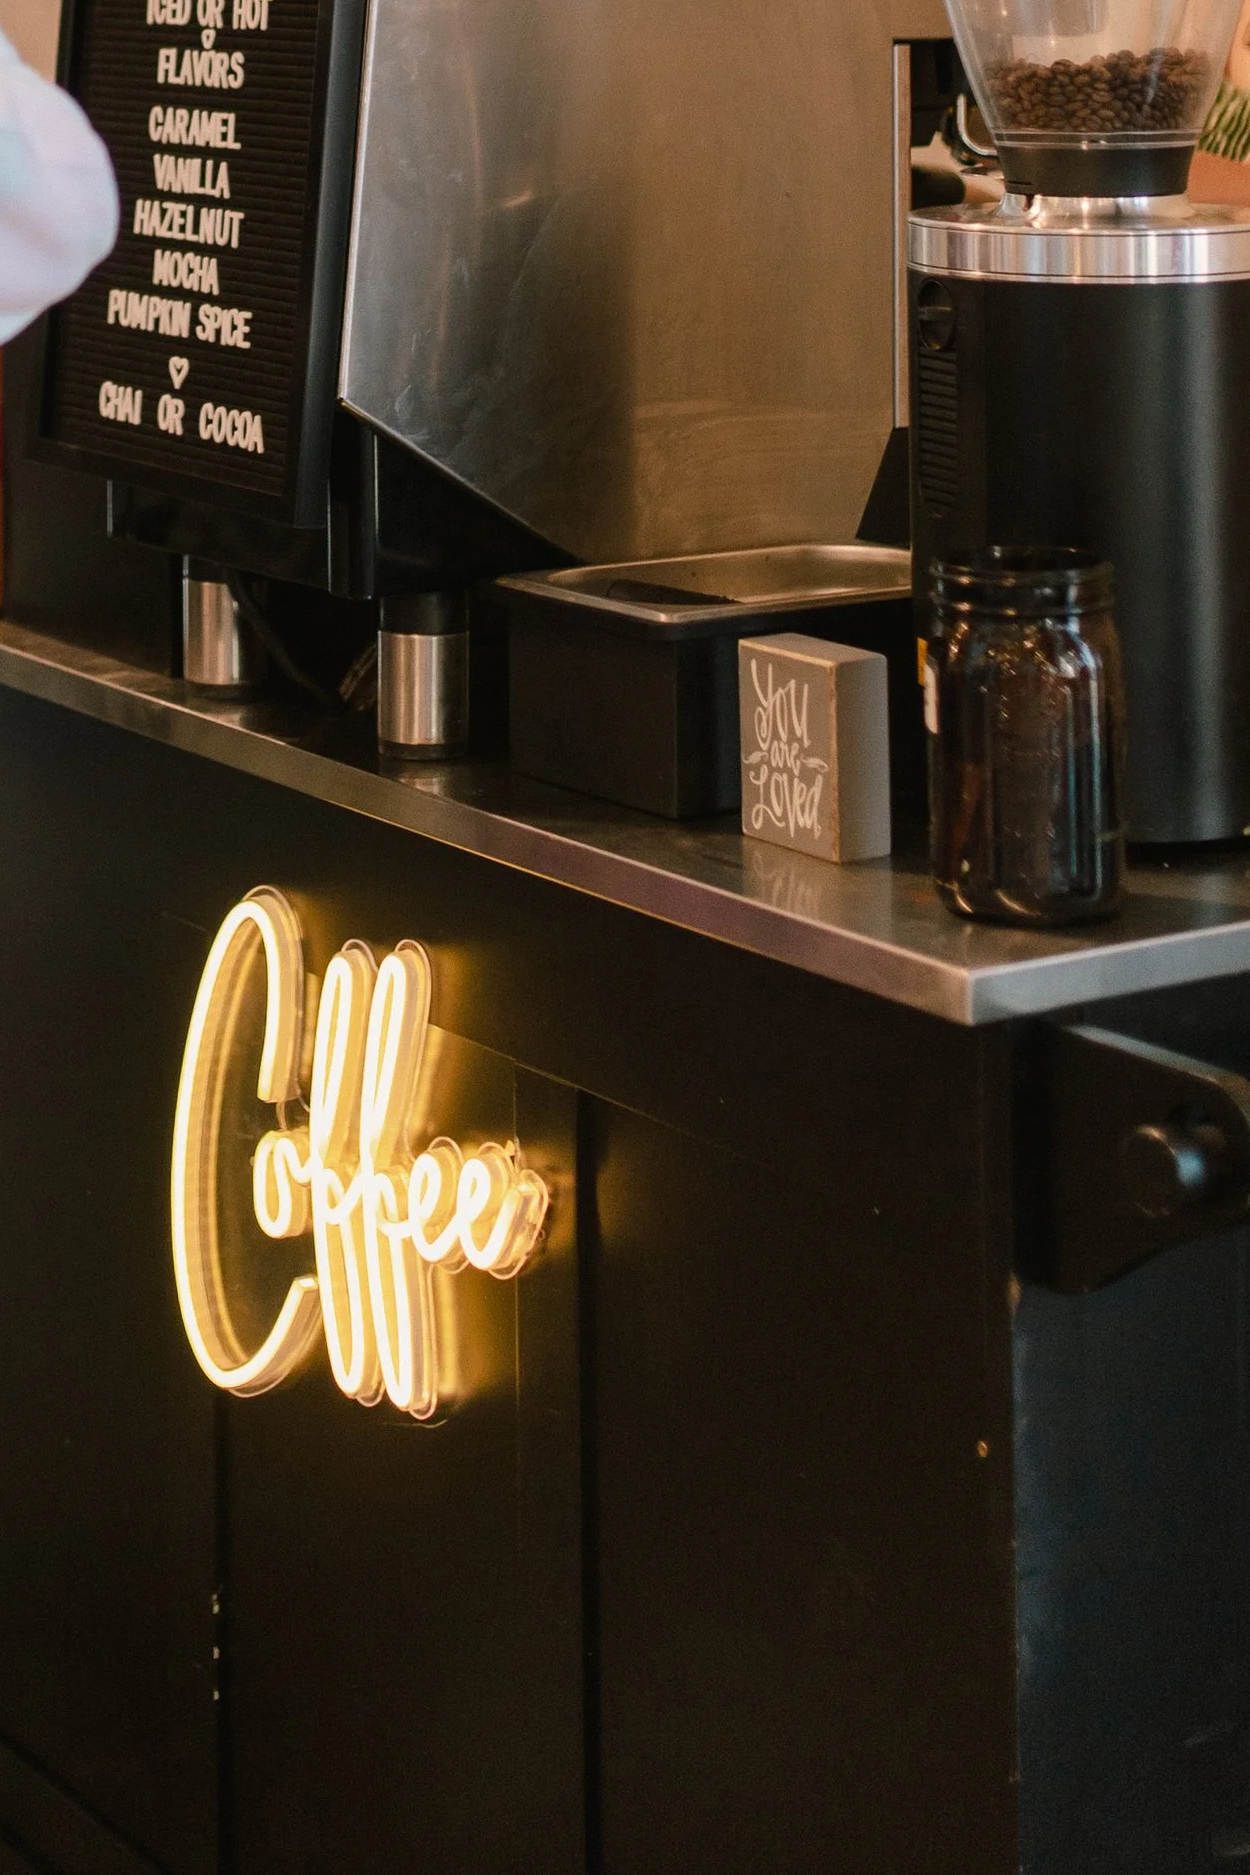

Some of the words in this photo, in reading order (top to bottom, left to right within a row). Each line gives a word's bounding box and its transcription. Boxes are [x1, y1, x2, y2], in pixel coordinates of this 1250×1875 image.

[156, 46, 246, 89] FLAVORS
[148, 105, 242, 150] CARAMEL
[153, 153, 231, 200] VANILLA
[133, 198, 246, 249] HAZELNUT
[152, 249, 220, 296] MOCHA
[107, 289, 192, 339] PUMPKIN
[196, 303, 253, 349] SPICE
[98, 380, 143, 425] CHAI
[157, 393, 186, 436] OR
[199, 402, 265, 454] COCOA
[750, 657, 812, 751] You
[770, 741, 800, 777] are
[749, 763, 824, 841] Loved
[169, 889, 545, 1415] Coffee
